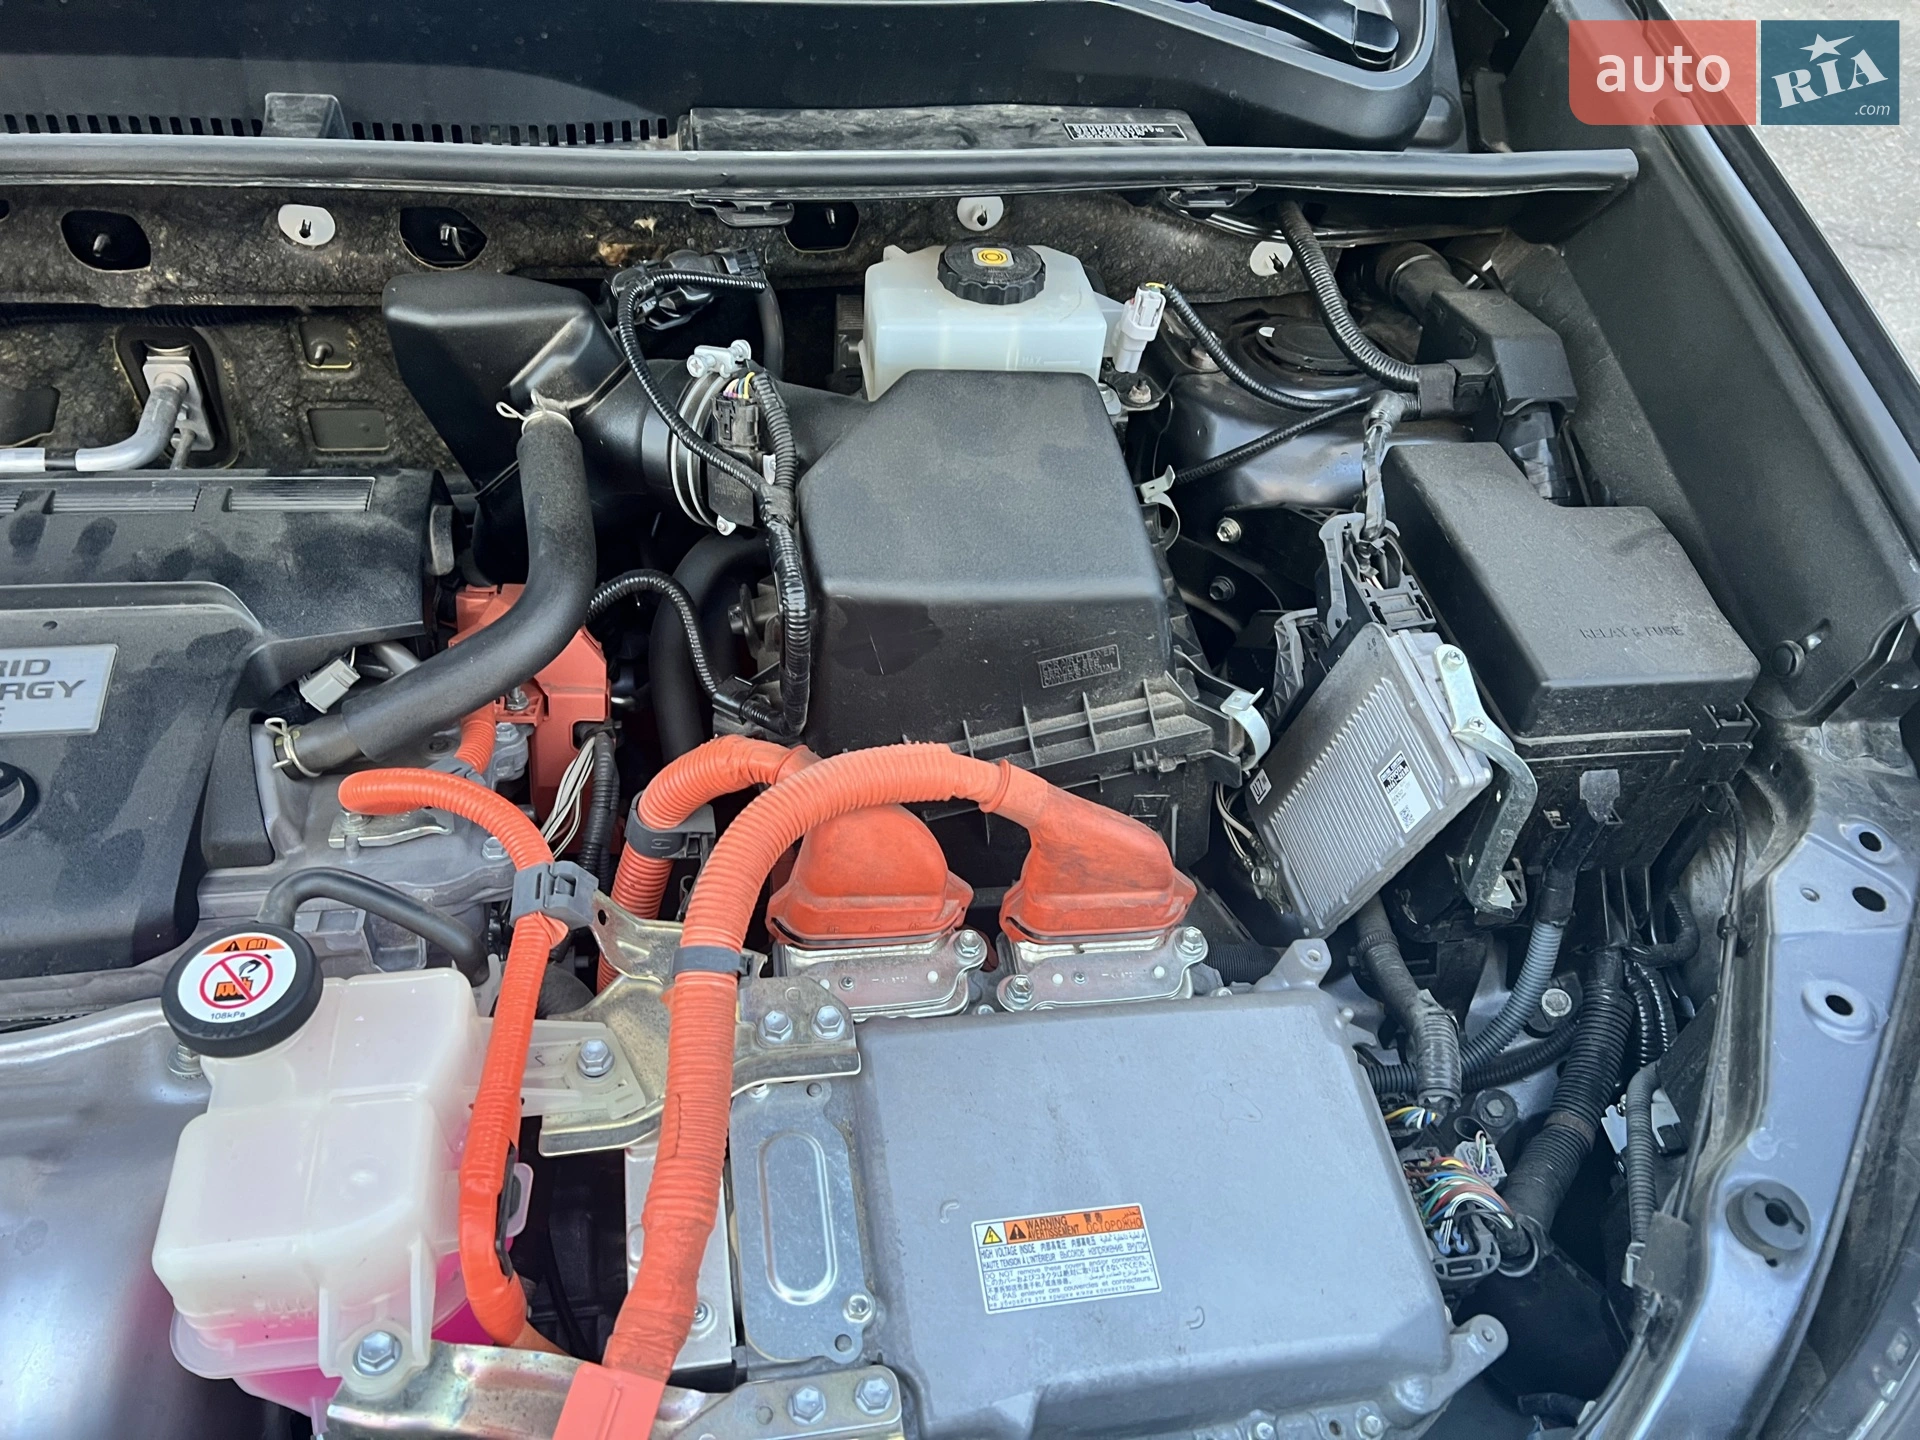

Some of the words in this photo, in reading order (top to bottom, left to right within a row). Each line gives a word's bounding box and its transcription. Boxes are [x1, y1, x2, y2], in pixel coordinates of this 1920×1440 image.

[1579, 627, 1627, 640] RELAY
[1644, 625, 1684, 637] FUSE
[211, 1011, 246, 1020] 108kPa
[1025, 1216, 1068, 1231] WARNING
[1086, 1217, 1143, 1234] ОСТОРОЖНО
[1028, 1224, 1081, 1240] AVERTISSEMENT
[980, 1249, 994, 1260] HIGH
[995, 1246, 1018, 1258] VOLTAGE
[1019, 1243, 1036, 1255] INSIDE
[982, 1260, 999, 1270] HAUTE
[1000, 1257, 1022, 1268] TENSION
[999, 1270, 1014, 1278] NOT
[1018, 1268, 1041, 1276] remove
[1064, 1262, 1086, 1270] covers
[1020, 1289, 1045, 1297] enlever
[1063, 1281, 1099, 1292] couvercles
